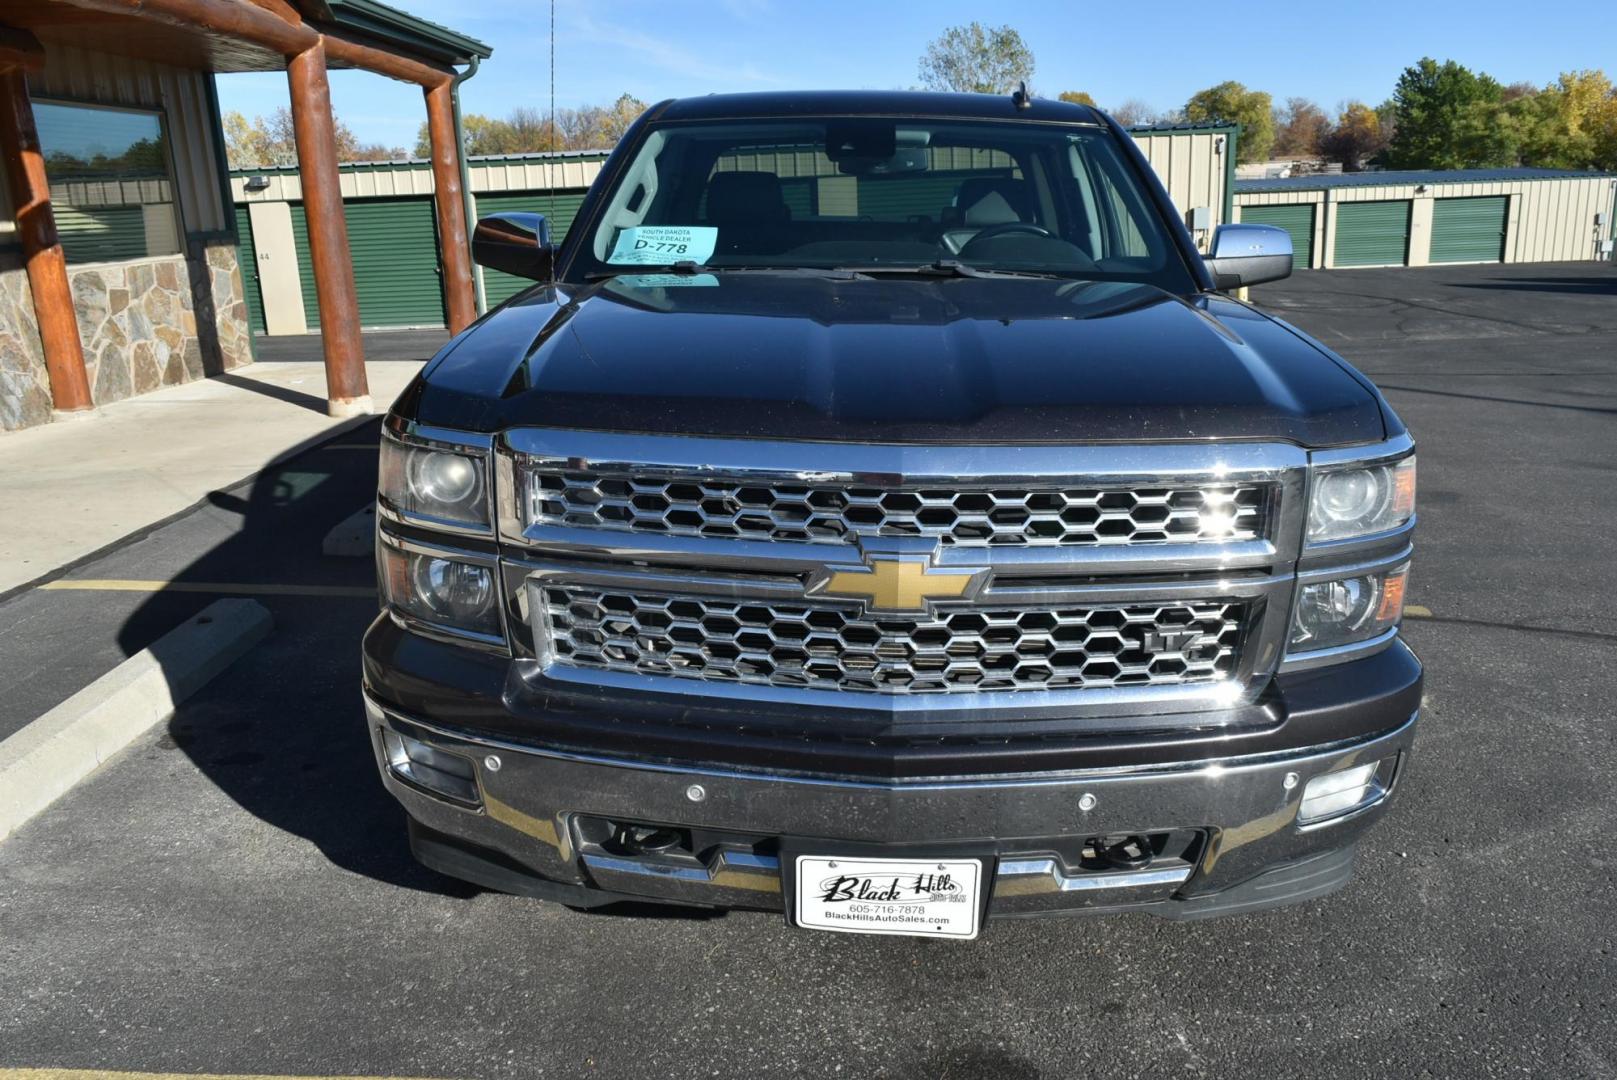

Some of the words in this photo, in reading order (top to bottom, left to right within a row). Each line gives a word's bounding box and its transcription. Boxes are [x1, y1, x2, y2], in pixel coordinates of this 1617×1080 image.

[634, 239, 688, 254] D-778
[260, 252, 270, 260] 44
[1144, 630, 1204, 654] LTZ
[820, 875, 900, 903] Black
[909, 872, 955, 894] Hills
[849, 904, 925, 915] 605-716-7878
[824, 911, 950, 925] BlackHillsAutoSales.com
